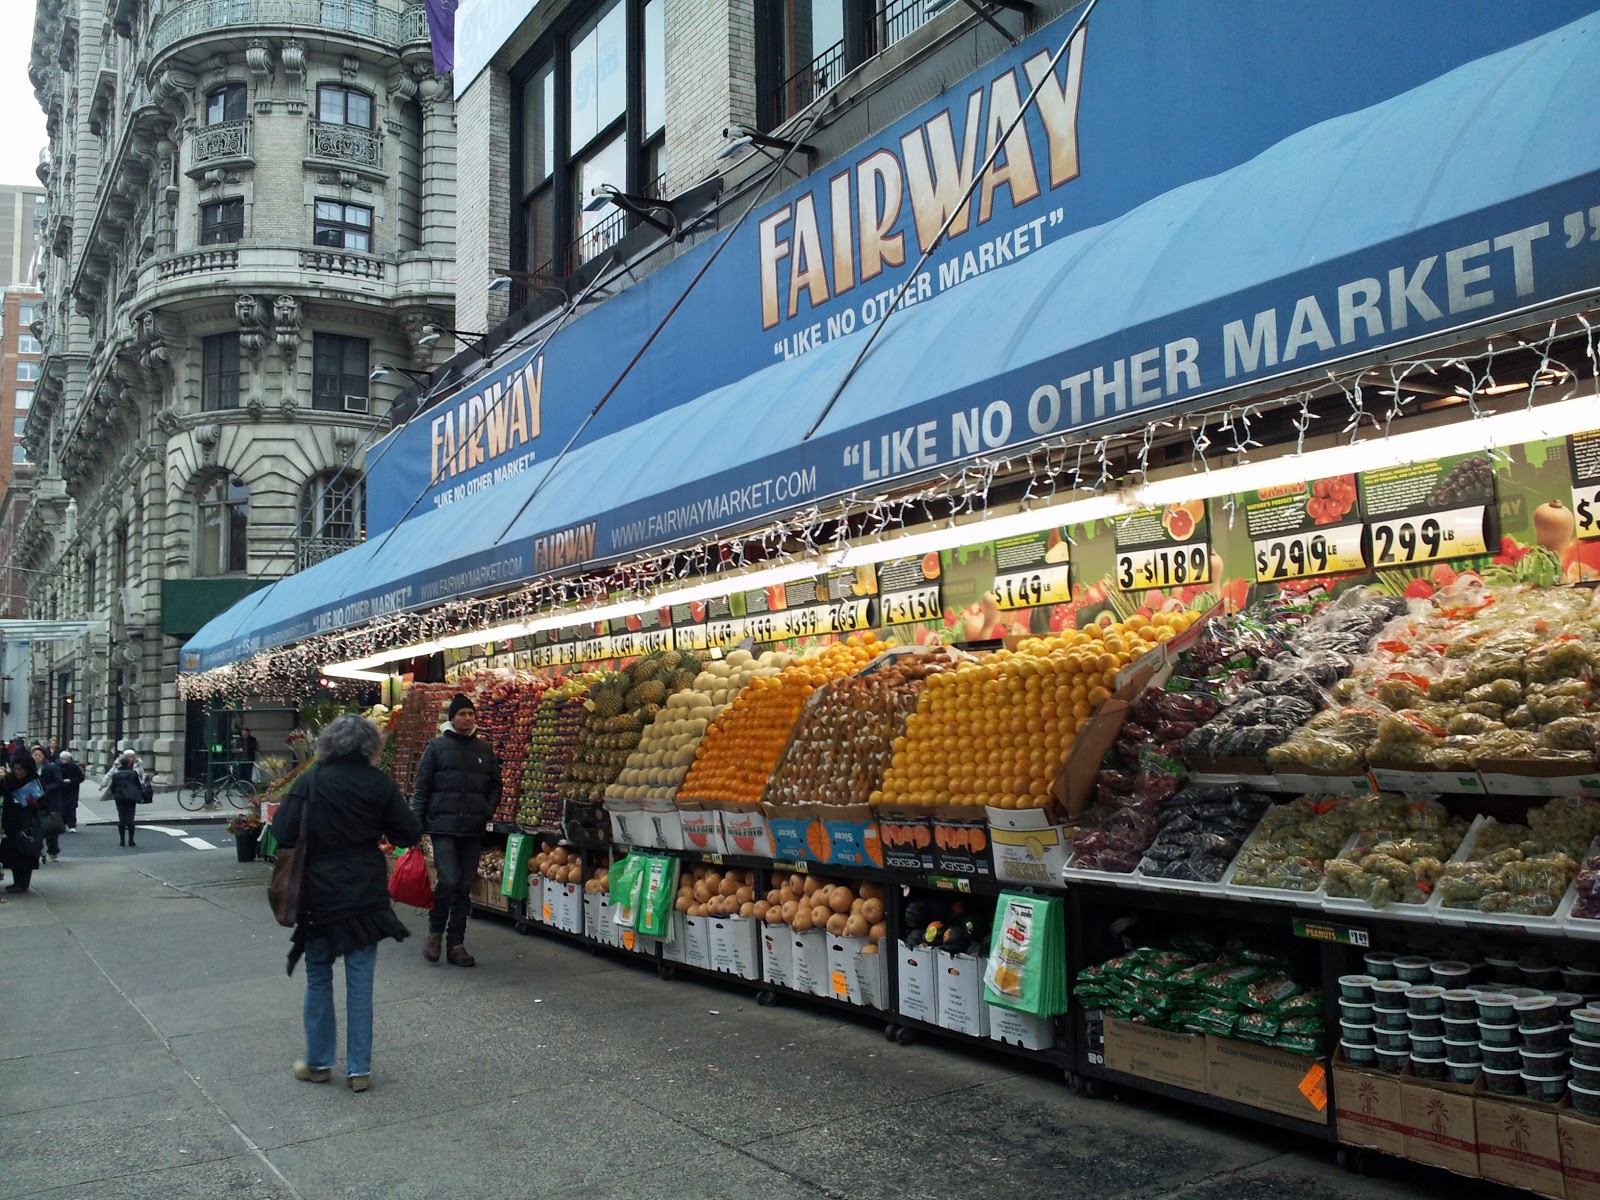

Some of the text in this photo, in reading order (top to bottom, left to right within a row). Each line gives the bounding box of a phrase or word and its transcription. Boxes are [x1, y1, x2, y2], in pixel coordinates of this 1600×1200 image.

[758, 22, 1089, 332] FAIRWAY
[774, 208, 1063, 362] “LIKE NO OTHER MARKET”
[430, 353, 544, 487] FAIRWAY
[842, 408, 937, 482] “LIKE
[952, 400, 1012, 453] NO
[1028, 336, 1201, 435] OTHER
[454, 484, 466, 501] NO
[467, 472, 492, 498] OTHER
[611, 465, 816, 550] WWW.FAIRWAYMARKET.COM
[533, 521, 597, 574] FAIRWAY
[1443, 529, 1454, 541] LB
[1119, 556, 1133, 588] 3
[333, 607, 344, 627] NO
[345, 599, 370, 624] OTHER
[883, 598, 894, 623] 2
[886, 857, 920, 869] GESEX
[940, 860, 975, 873] GESEX
[1305, 928, 1336, 940] PEANUTS
[1160, 1031, 1192, 1045] PEANUTS
[1216, 1045, 1239, 1057] FRESH
[1274, 1057, 1308, 1073] PEANUTS
